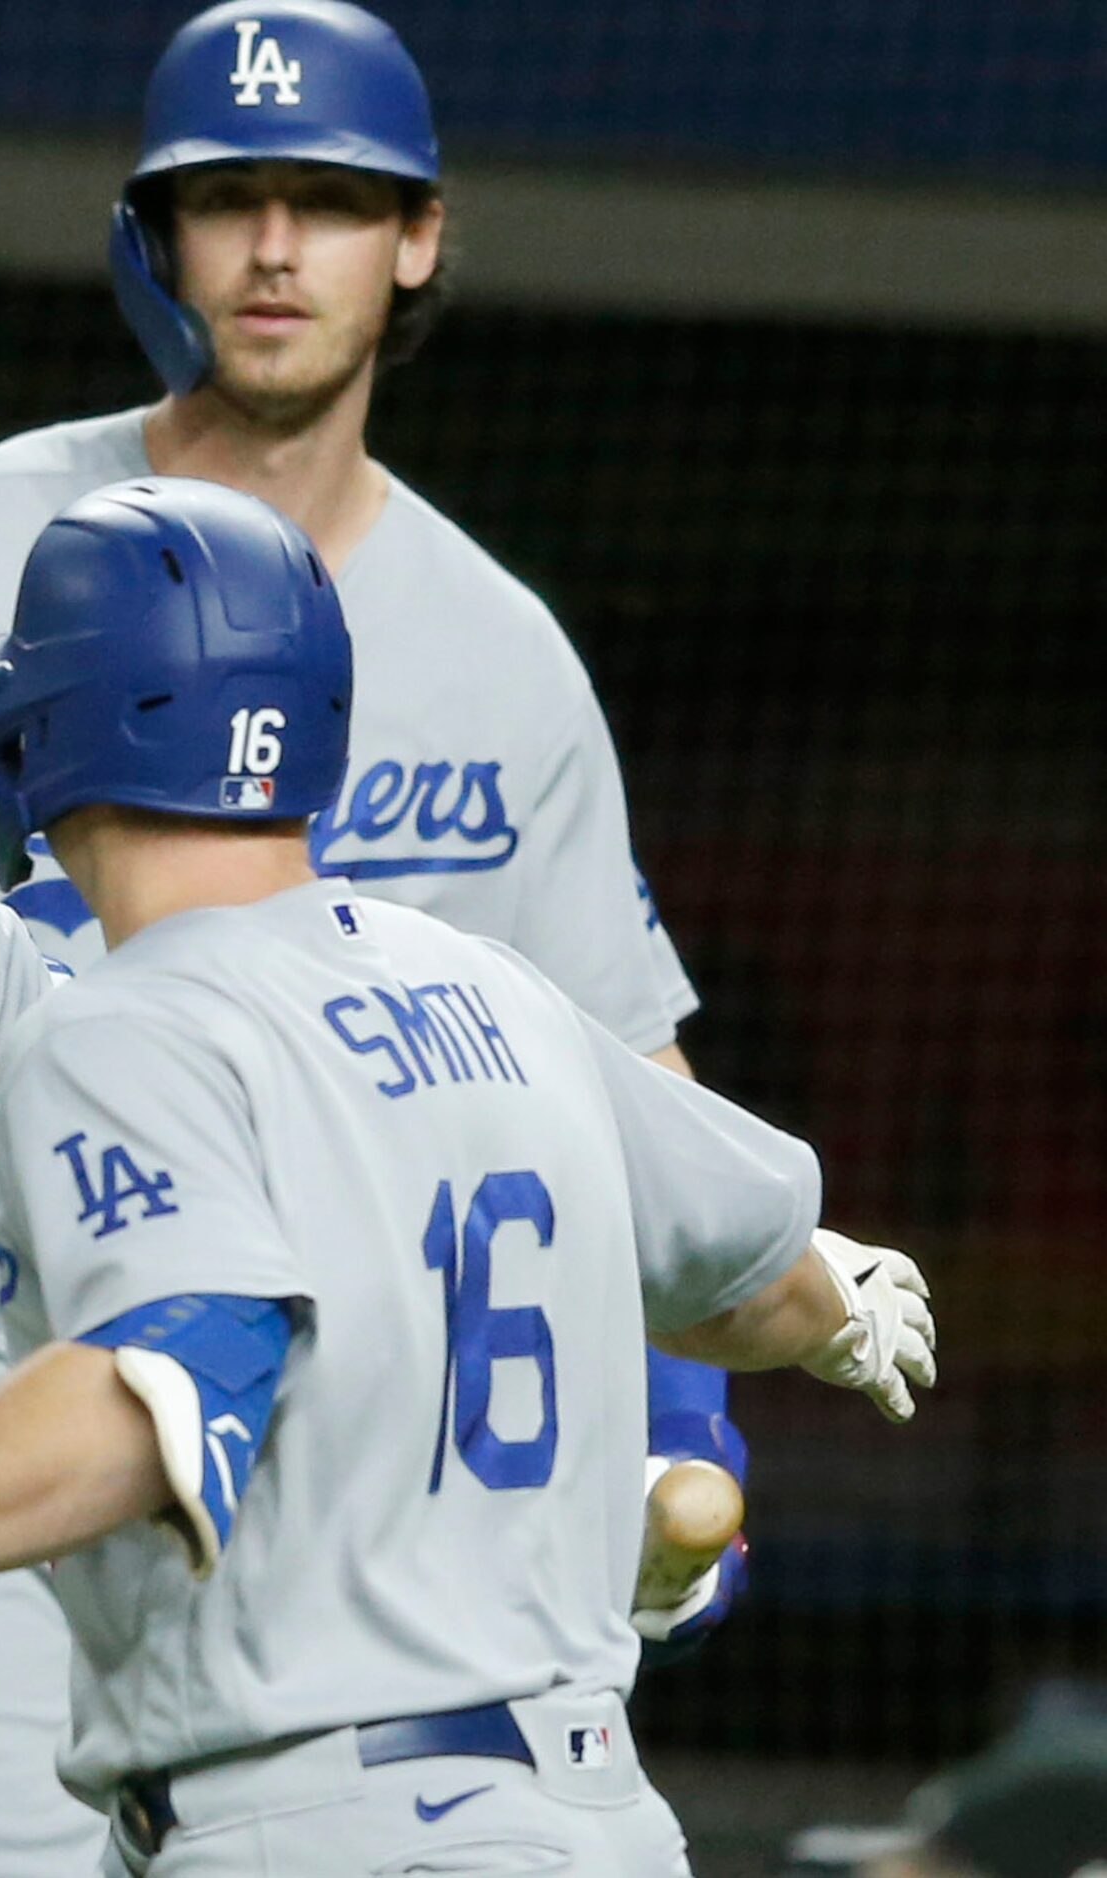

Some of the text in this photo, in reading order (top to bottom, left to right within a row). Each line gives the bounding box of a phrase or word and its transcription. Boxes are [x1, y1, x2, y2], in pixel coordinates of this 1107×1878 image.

[230, 20, 300, 106] LA
[228, 707, 286, 775] 16
[323, 979, 529, 1099] SMITH
[54, 1131, 179, 1240] LA
[423, 1170, 558, 1496] 16
